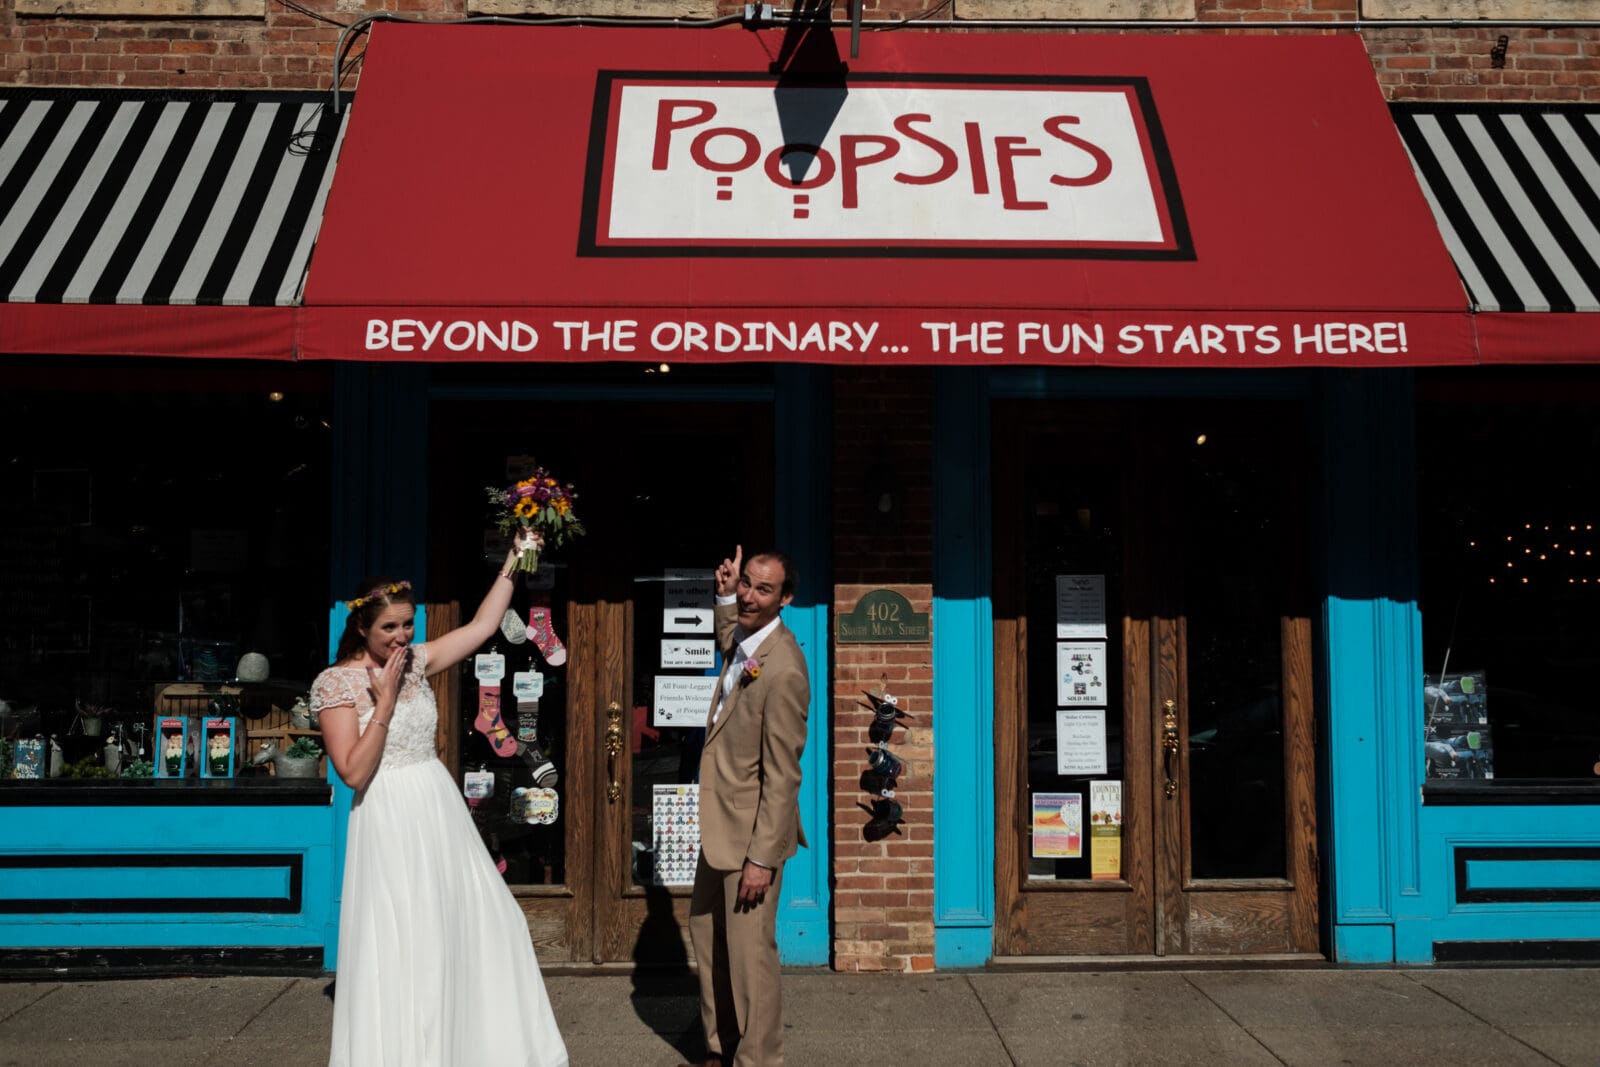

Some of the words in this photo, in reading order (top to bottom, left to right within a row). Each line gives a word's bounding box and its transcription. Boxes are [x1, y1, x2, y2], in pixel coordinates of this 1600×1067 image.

[652, 99, 1113, 218] POOPSIES
[365, 318, 538, 352] BEYOND
[552, 319, 638, 352] THE
[650, 321, 909, 354] ORDINARY...
[920, 321, 1004, 354] THE
[1018, 322, 1104, 355] FUN
[1117, 324, 1281, 355] STARTS
[1293, 321, 1408, 355] HERE!
[866, 602, 900, 622] 402
[684, 647, 711, 656] Smile
